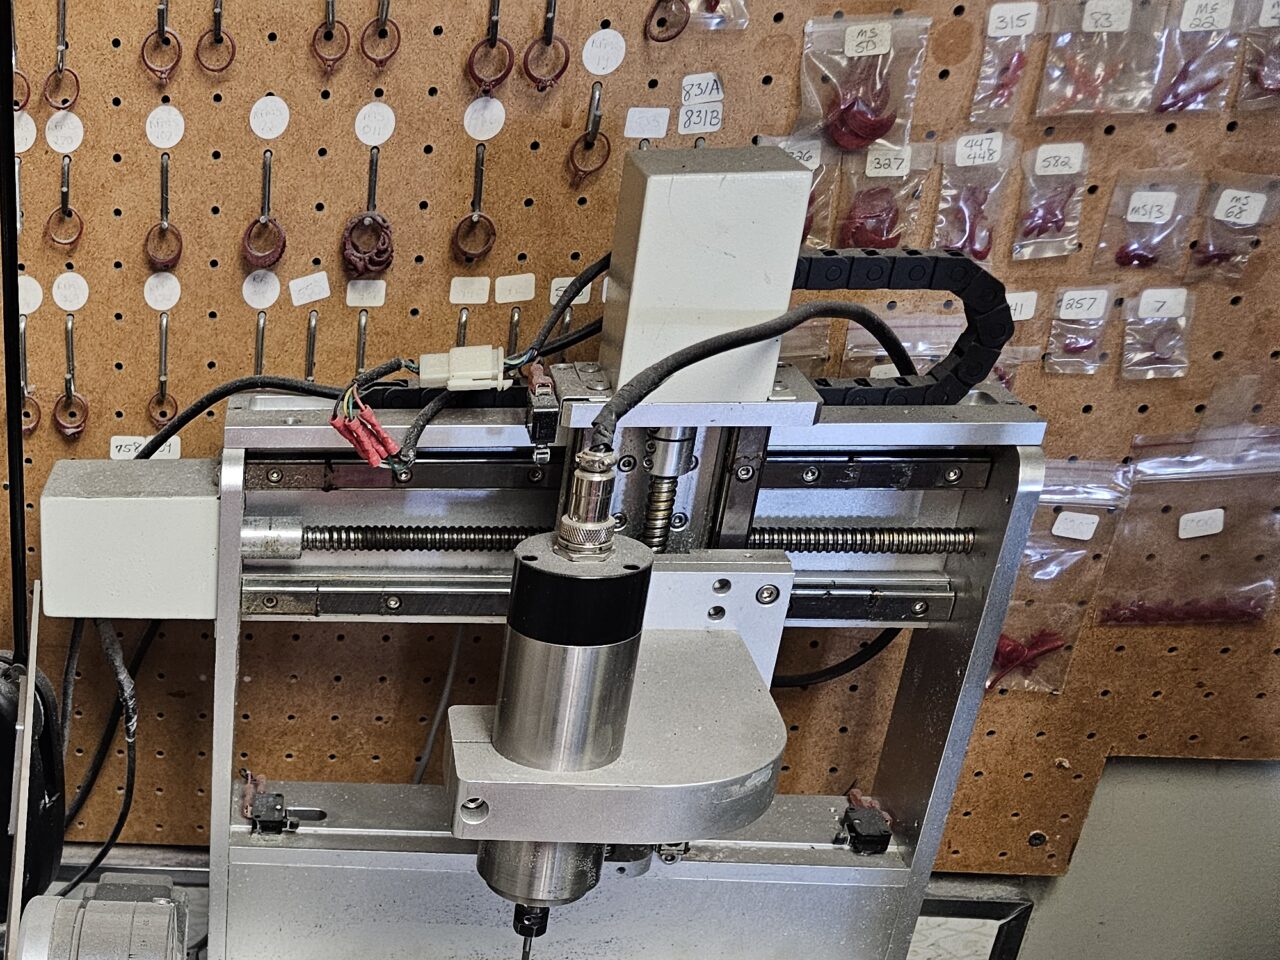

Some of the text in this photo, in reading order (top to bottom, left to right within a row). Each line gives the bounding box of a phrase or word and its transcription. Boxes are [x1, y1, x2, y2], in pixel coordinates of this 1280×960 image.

[994, 12, 1031, 30] 315
[682, 79, 720, 102] 831A
[683, 109, 721, 128] 831B
[874, 157, 904, 170] 327
[1042, 156, 1073, 169] 582
[1064, 297, 1097, 312] 257
